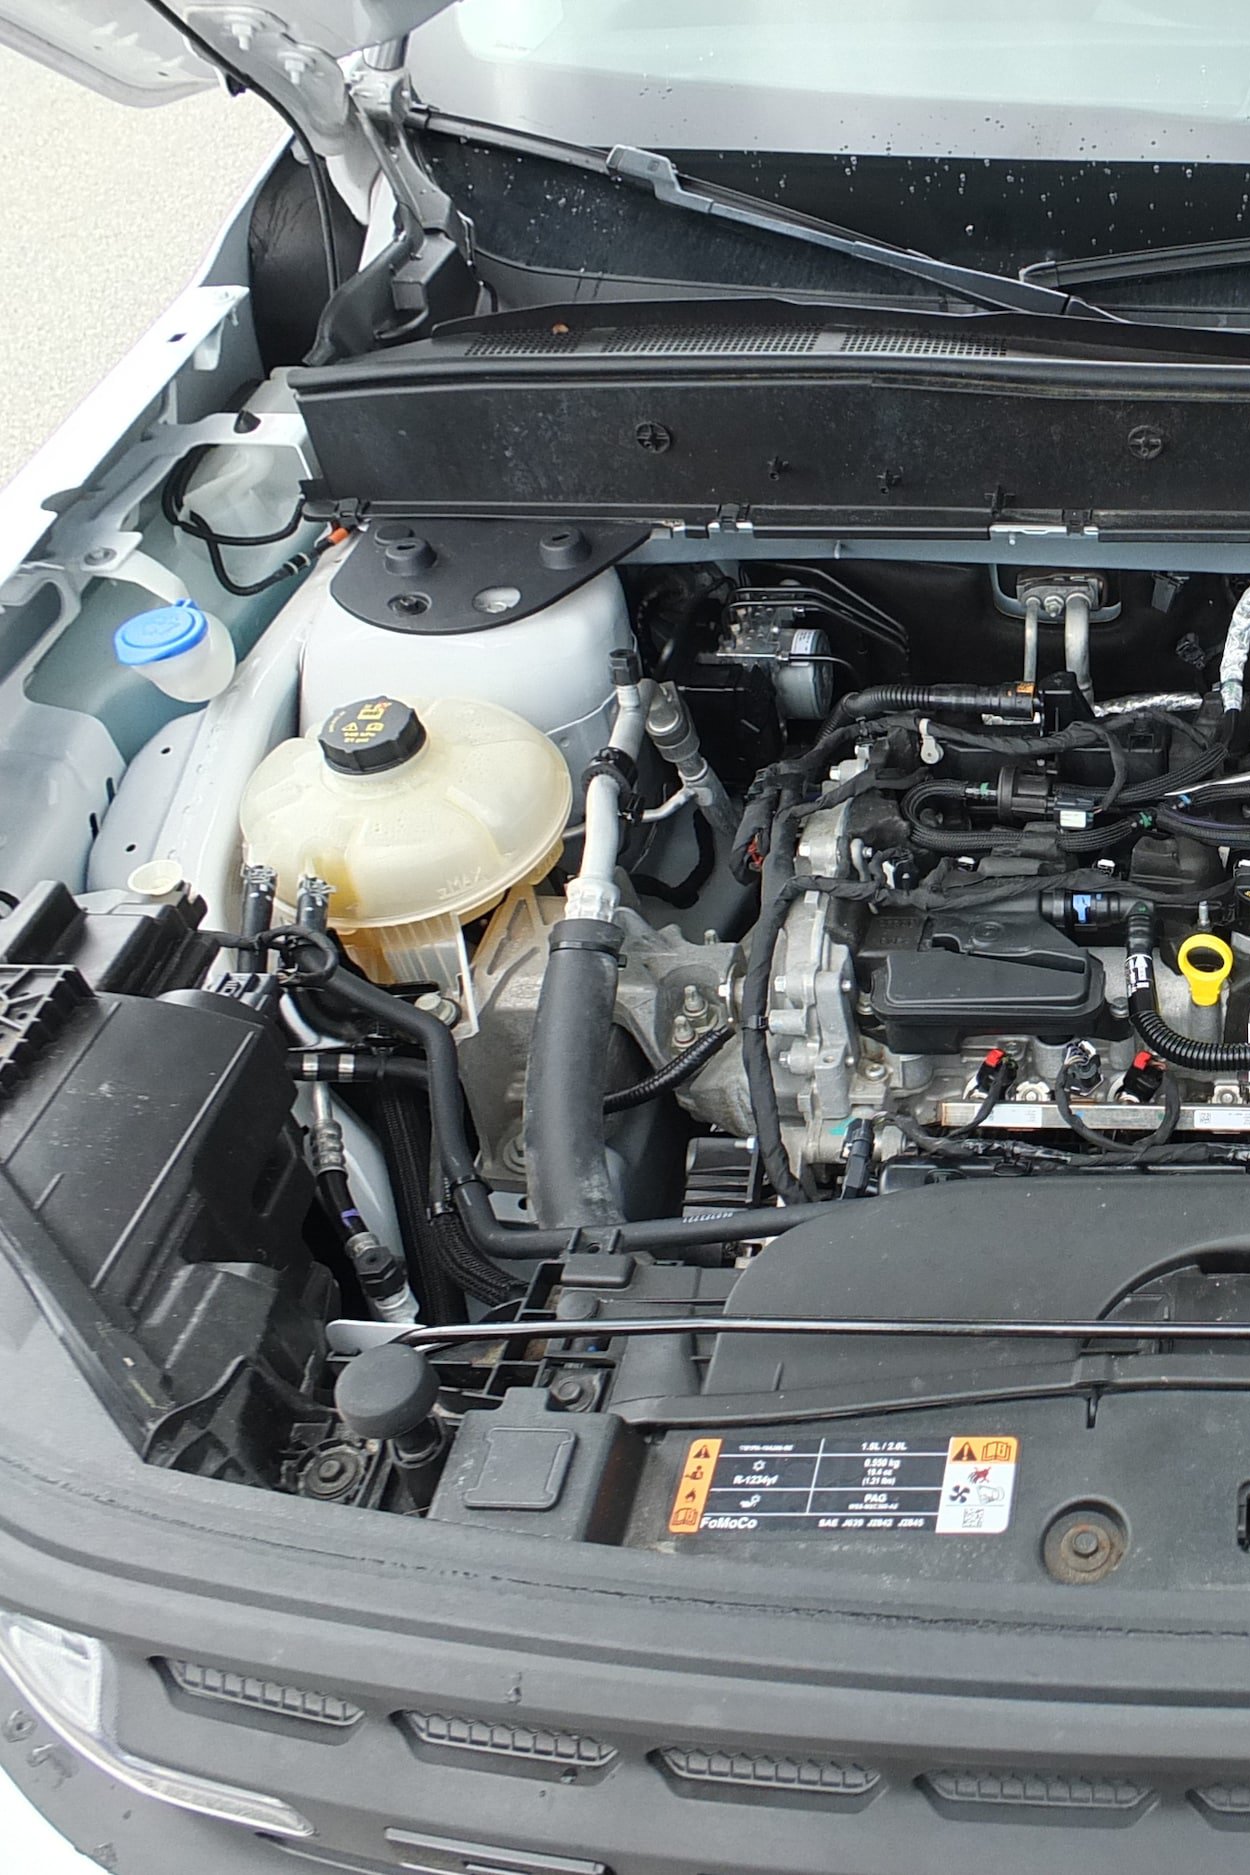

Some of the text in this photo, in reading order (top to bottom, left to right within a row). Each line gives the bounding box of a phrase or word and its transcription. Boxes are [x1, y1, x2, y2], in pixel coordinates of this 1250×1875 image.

[887, 1441, 908, 1451] 2.0L
[864, 1493, 887, 1503] PAG
[700, 1516, 758, 1529] FoMoCo
[818, 1518, 838, 1527] SAE
